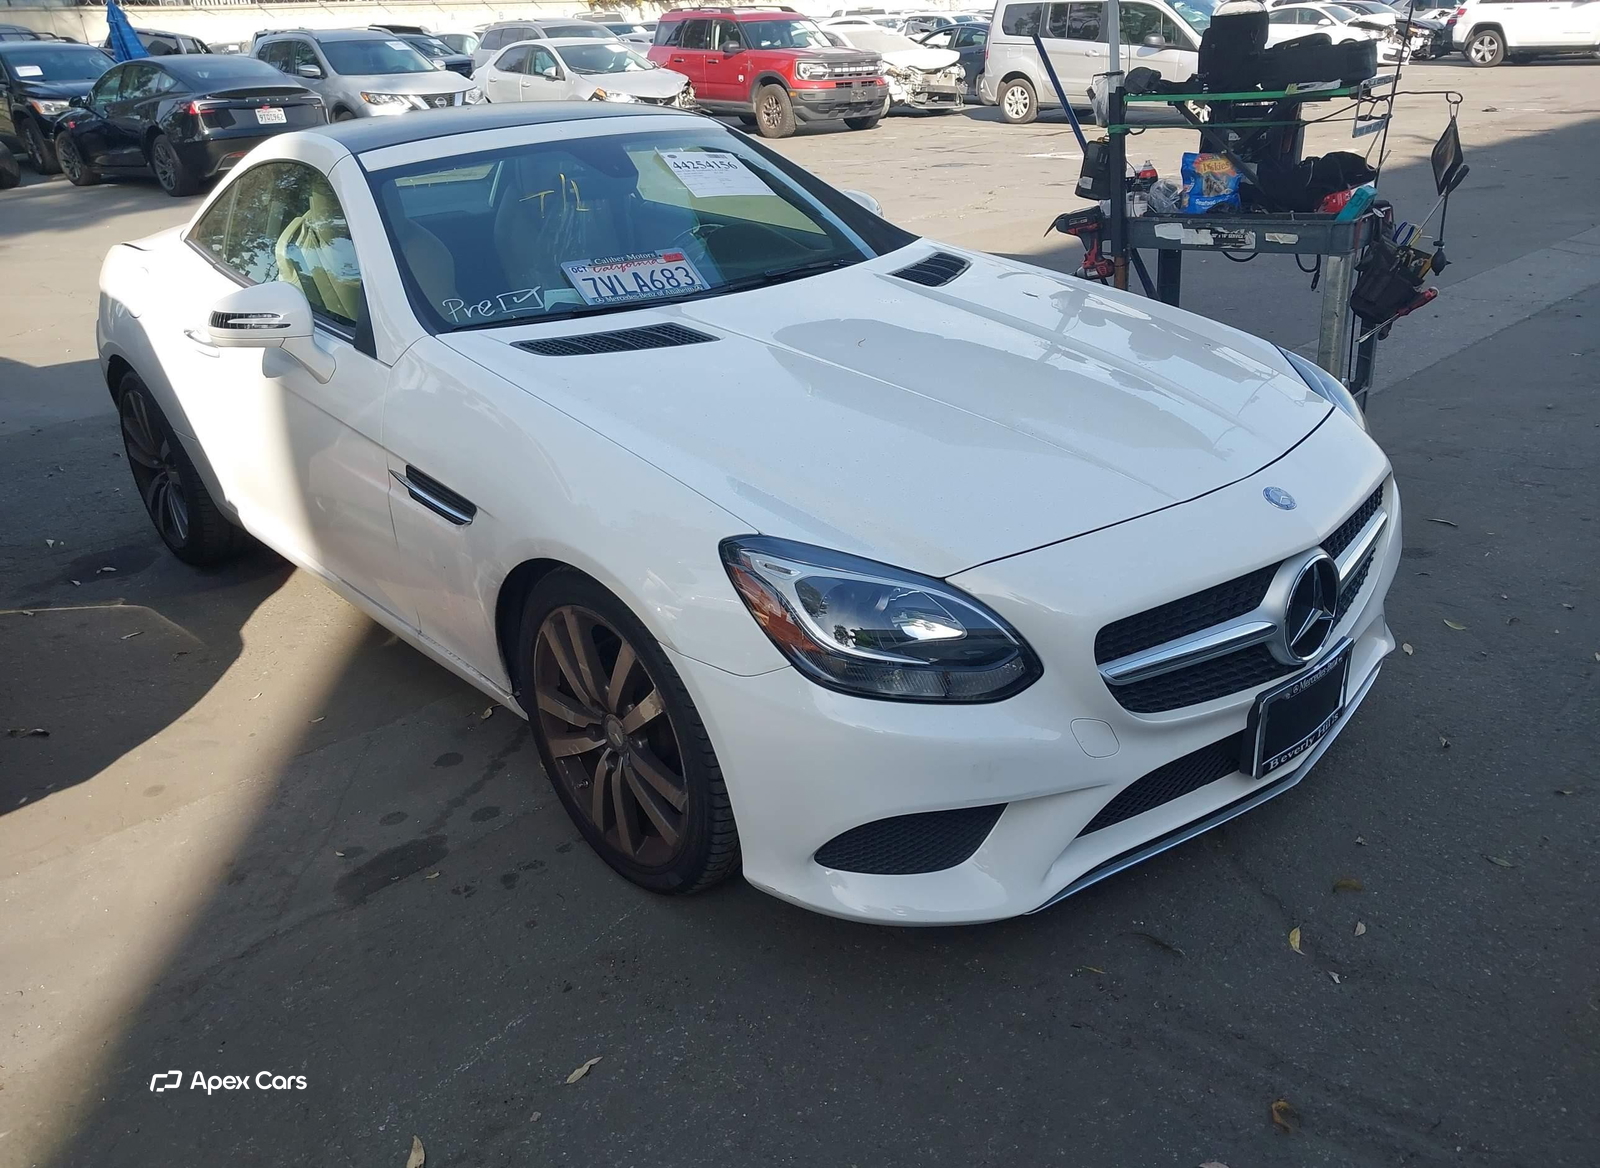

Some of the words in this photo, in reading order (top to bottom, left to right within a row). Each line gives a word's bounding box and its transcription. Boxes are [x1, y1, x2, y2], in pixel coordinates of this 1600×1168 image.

[672, 159, 739, 170] 44254156
[593, 258, 658, 273] California
[594, 255, 625, 265] Caliber
[625, 252, 656, 262] Motors
[571, 266, 588, 274] OCT
[581, 266, 696, 299] 7VLA683
[442, 298, 495, 323] Pre
[1268, 735, 1316, 771] Beverly
[1317, 712, 1339, 738] Hills
